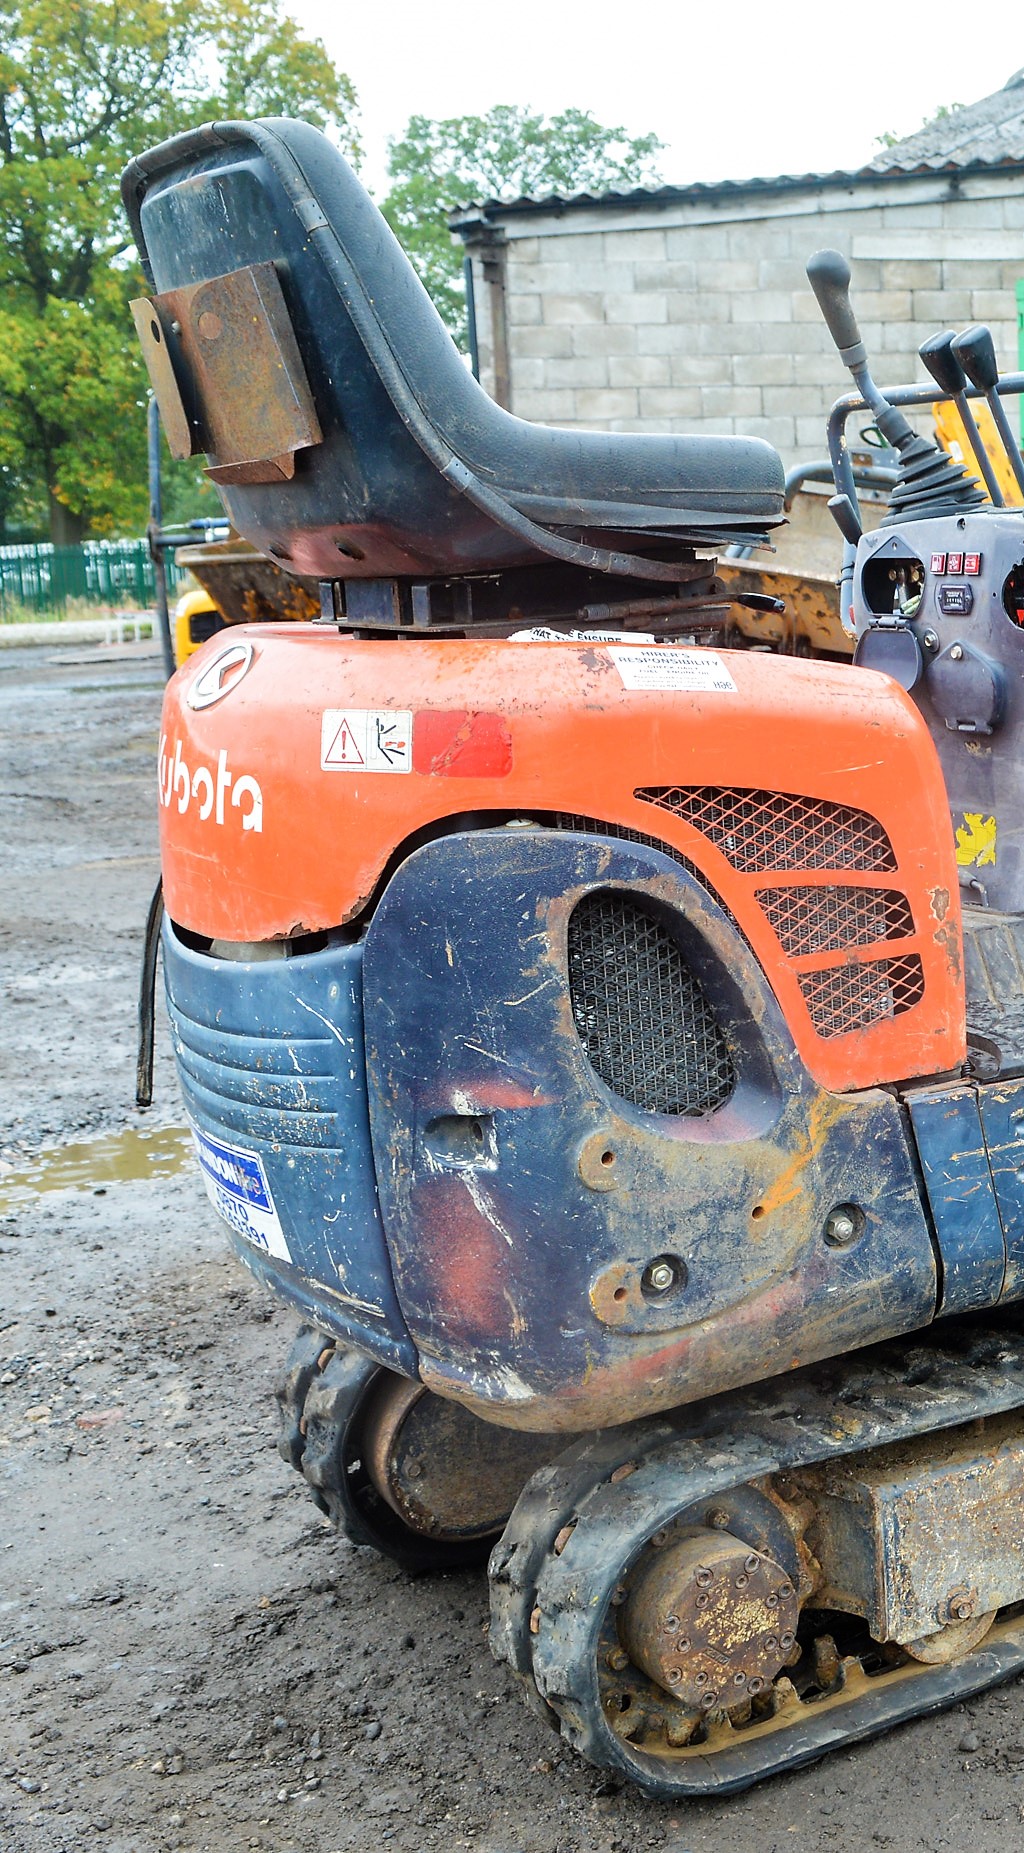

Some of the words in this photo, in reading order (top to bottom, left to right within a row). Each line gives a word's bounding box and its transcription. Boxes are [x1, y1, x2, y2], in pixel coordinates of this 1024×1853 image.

[640, 651, 690, 659] HIRER'S
[618, 656, 718, 667] RESPONSIBILITY
[158, 732, 263, 833] Kubota
